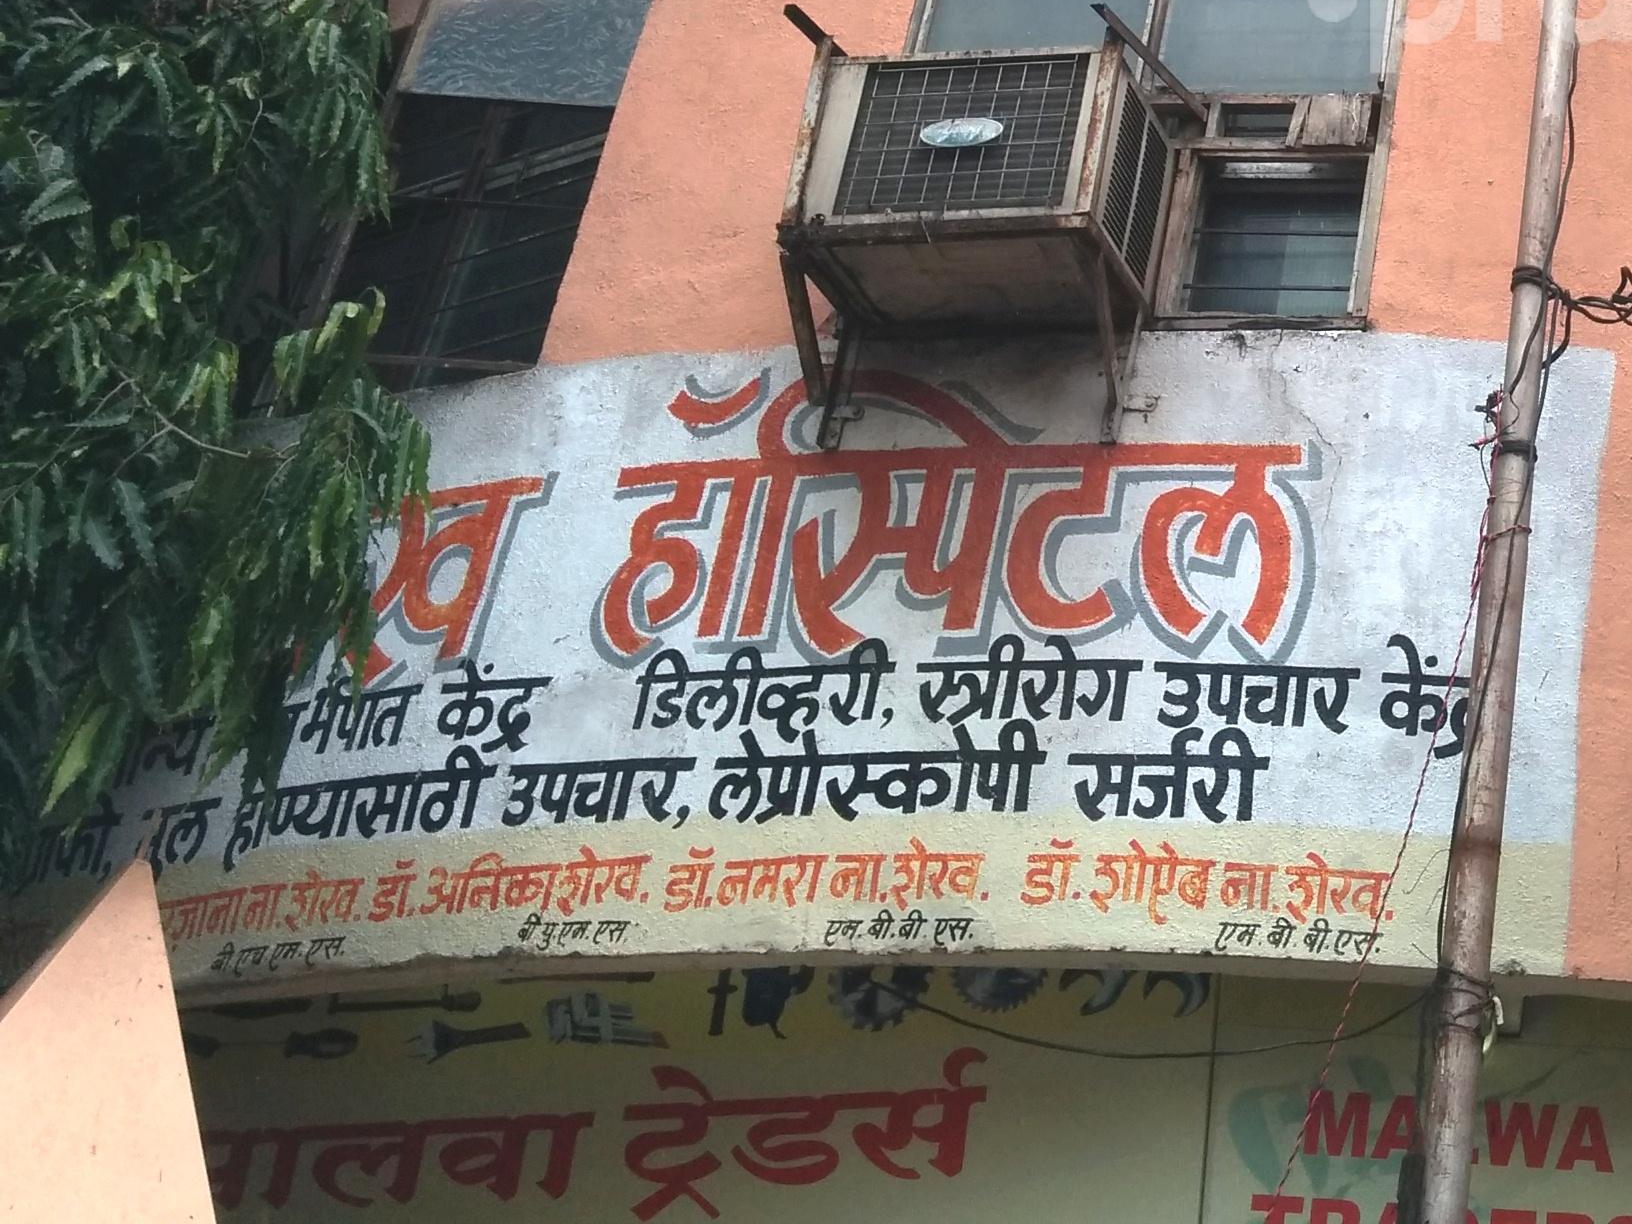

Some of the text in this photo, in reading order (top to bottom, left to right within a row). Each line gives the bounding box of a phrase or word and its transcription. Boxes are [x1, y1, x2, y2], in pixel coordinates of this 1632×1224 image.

[596, 370, 1312, 663] हॉस्पिटल
[436, 659, 554, 753] केंद्र
[916, 636, 1143, 735] स्त्रीरोग
[1154, 660, 1360, 735] उपचार
[1067, 725, 1269, 825] सर्जरी
[622, 1046, 989, 1222] ट्रेडर्स
[1303, 1088, 1615, 1174] MAWA
